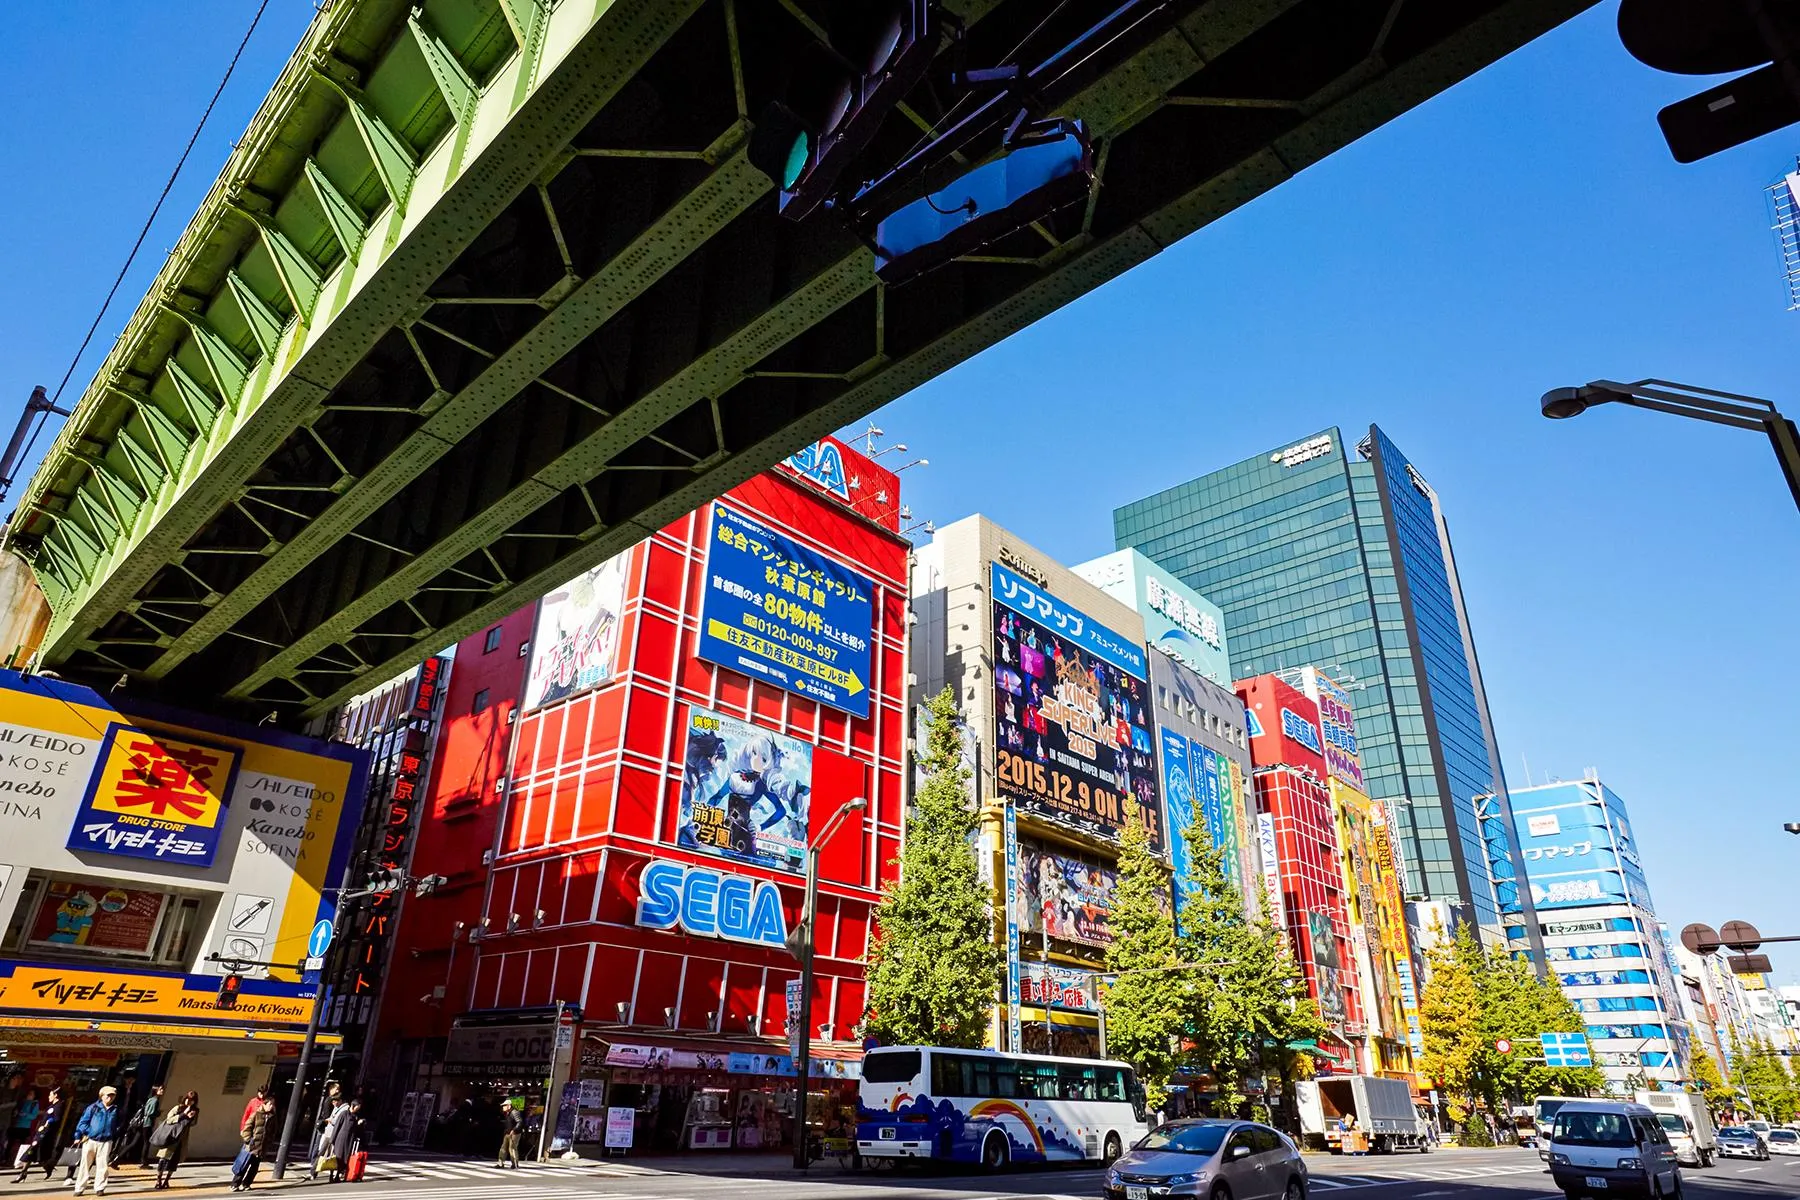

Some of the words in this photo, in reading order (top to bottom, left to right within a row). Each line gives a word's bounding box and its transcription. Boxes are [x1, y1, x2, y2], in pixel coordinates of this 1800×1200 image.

[717, 523, 868, 603] 総合マンションギャラリー
[764, 565, 827, 609] 秋葉原館
[1000, 573, 1084, 637] ソフマップ
[727, 627, 849, 685] 住友不動産秋葉原ビル8F
[757, 618, 838, 662] 0120-009-897
[1089, 629, 1140, 667] アミューズメント館
[1064, 683, 1099, 711] KING
[1067, 731, 1097, 760] 2015
[1281, 707, 1323, 757] SEGA
[8, 754, 69, 776] KOSÉ
[114, 740, 219, 820] 薬
[244, 777, 335, 804] SHISEIDO
[998, 750, 1090, 811] 2015.12.9
[1094, 788, 1118, 822] ON
[117, 814, 151, 828] DRUG
[151, 819, 187, 832] STORE
[244, 818, 315, 842] Kanebo
[279, 804, 324, 822] KOSÉ
[1219, 760, 1240, 876] メロンブックス
[83, 822, 208, 857] マツモトキヨシ
[246, 840, 307, 860] SOFINA
[699, 823, 731, 849] 学園
[1259, 817, 1275, 858] AKKY
[635, 859, 788, 949] SEGA
[31, 977, 159, 1007] マツモトキヨシ
[178, 998, 256, 1013] Matsoto
[257, 1003, 305, 1016] KiYoshi
